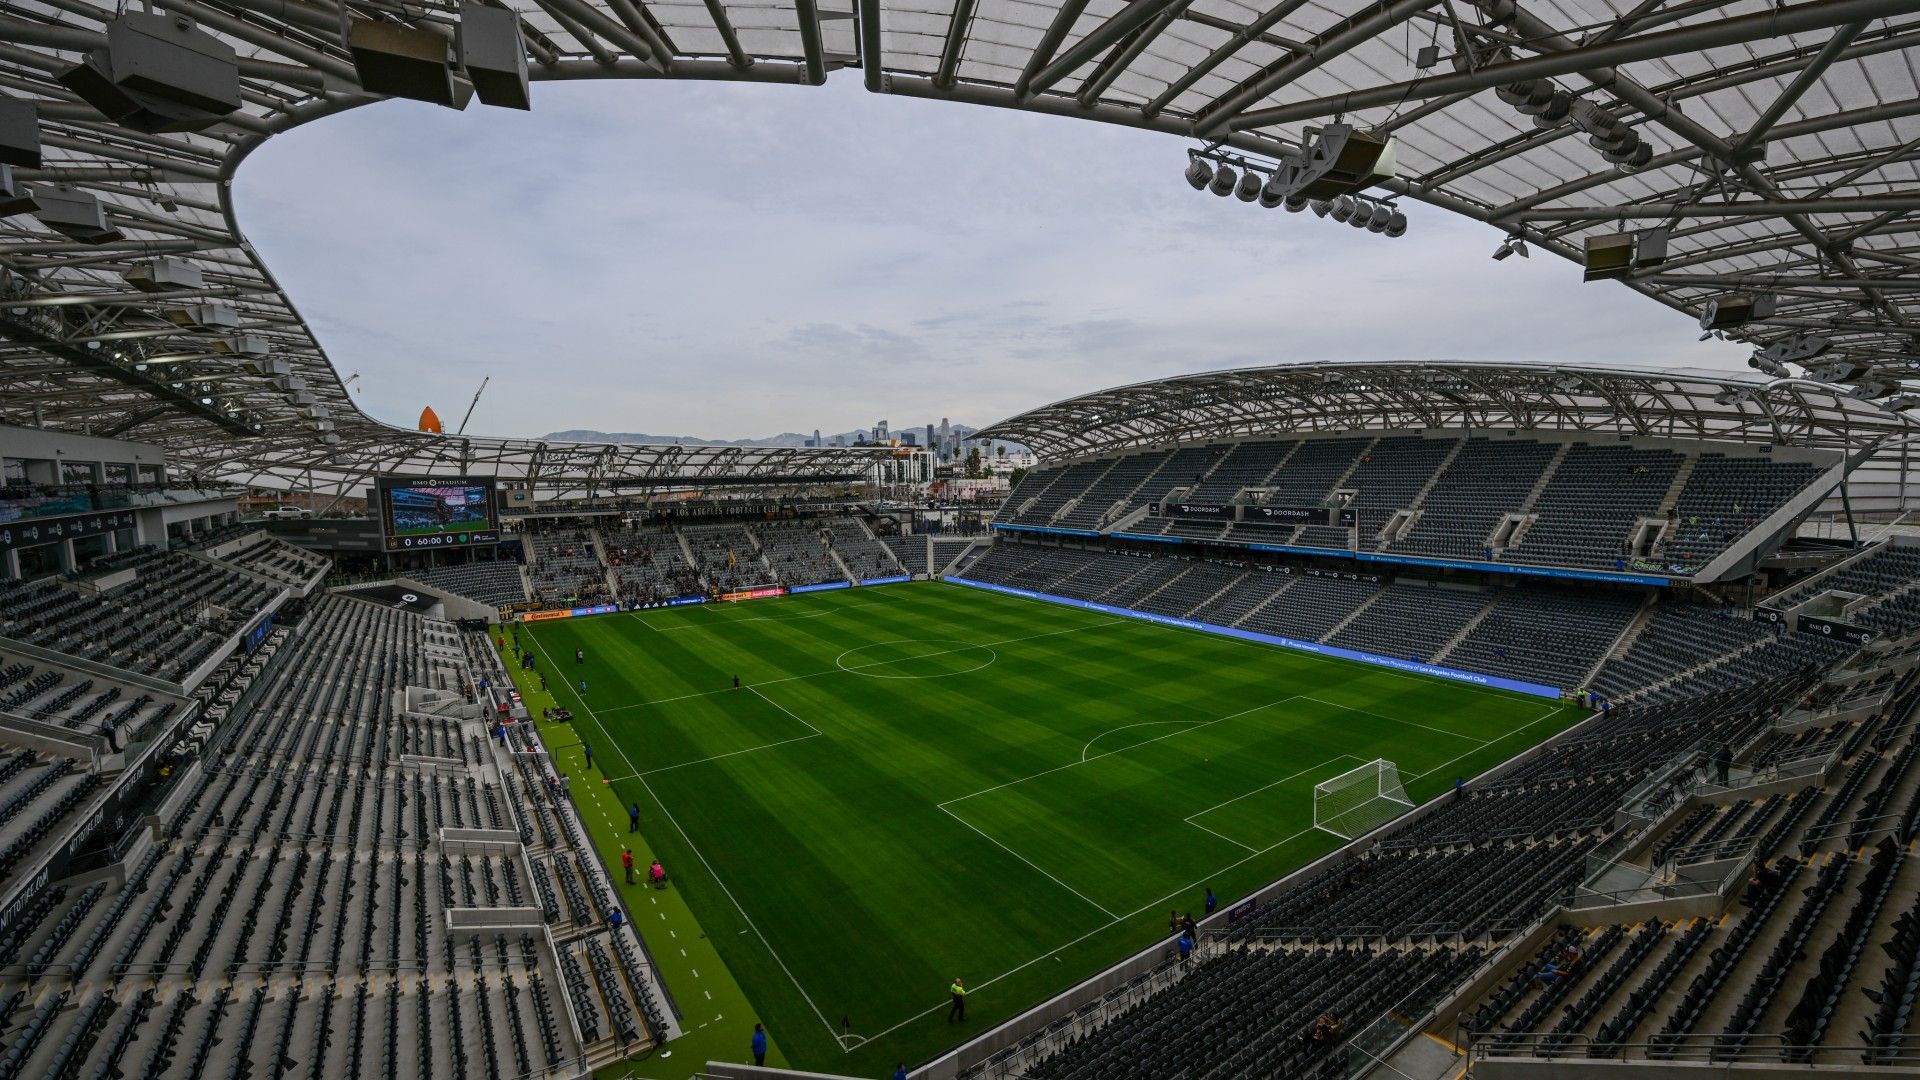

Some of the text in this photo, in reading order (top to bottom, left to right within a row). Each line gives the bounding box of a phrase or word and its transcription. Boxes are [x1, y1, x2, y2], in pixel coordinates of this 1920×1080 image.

[676, 508, 689, 516] LOS
[693, 507, 723, 516] ANGELES
[763, 505, 780, 514] CLUB
[404, 538, 412, 547] 0
[417, 537, 442, 546] 60:00
[446, 535, 453, 544] 0
[531, 612, 560, 620] Continental
[1808, 623, 1822, 631] BMO
[1846, 631, 1860, 639] BMO
[1428, 668, 1450, 677] Angeles
[1450, 672, 1473, 680] Football
[0, 866, 49, 932] NITTOTIRE.COM
